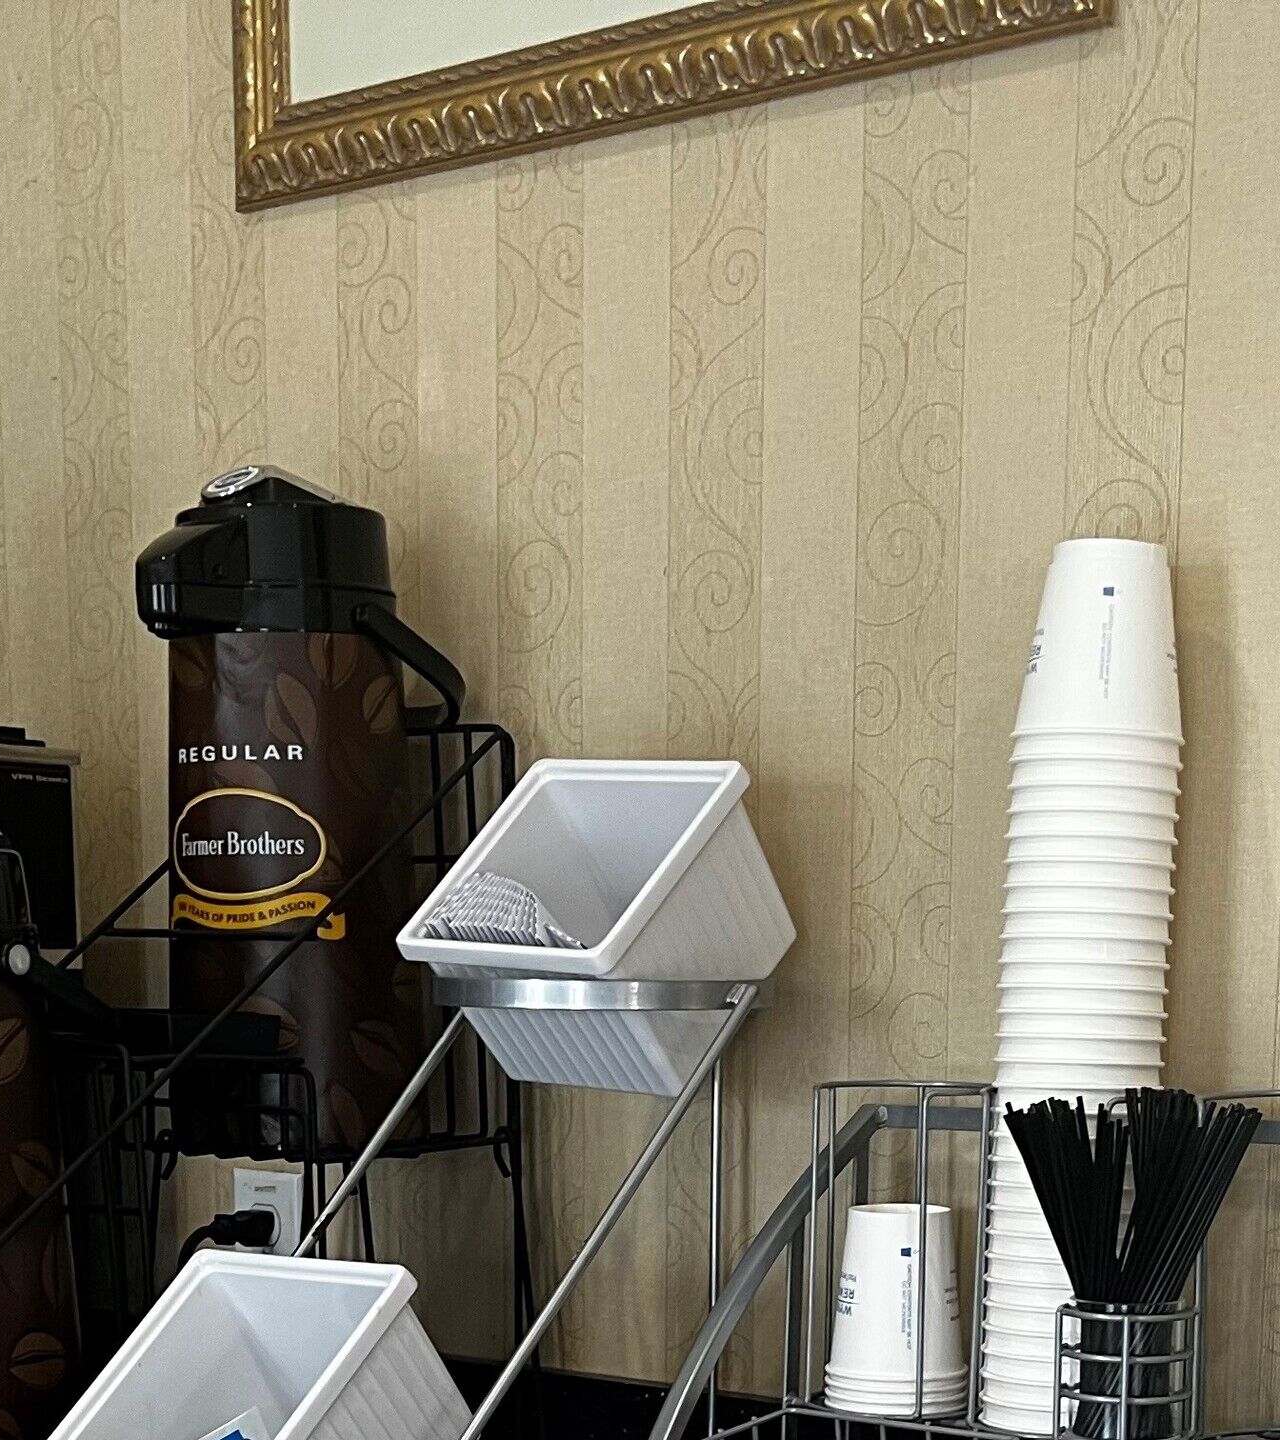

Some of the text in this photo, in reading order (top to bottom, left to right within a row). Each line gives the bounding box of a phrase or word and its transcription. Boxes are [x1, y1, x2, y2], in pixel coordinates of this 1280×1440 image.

[178, 744, 304, 764] REGULAR
[181, 830, 305, 857] Farmer Brothers
[226, 912, 257, 924] PRIDE
[257, 911, 267, 920] &
[268, 900, 316, 919] PASSION
